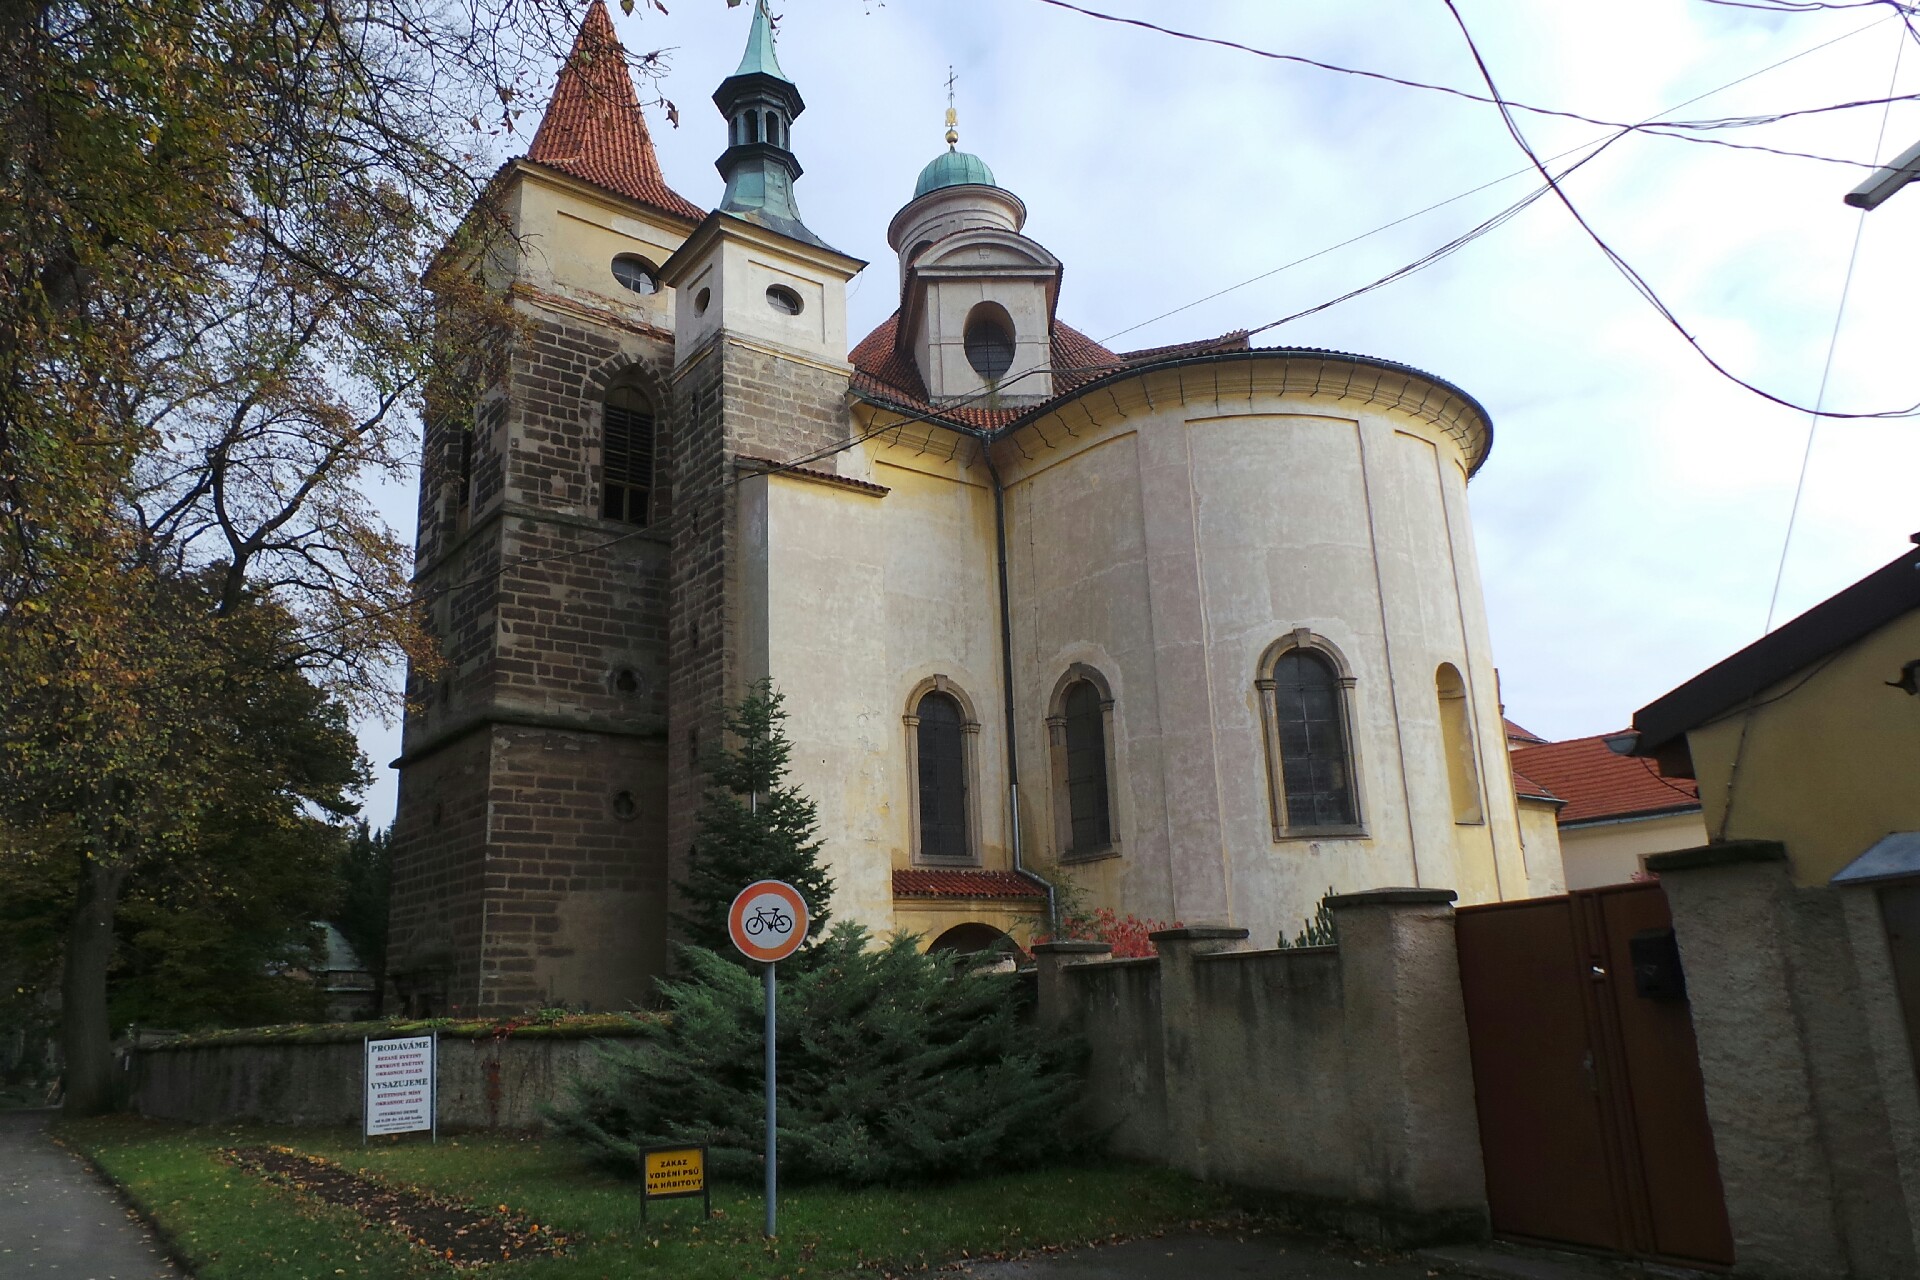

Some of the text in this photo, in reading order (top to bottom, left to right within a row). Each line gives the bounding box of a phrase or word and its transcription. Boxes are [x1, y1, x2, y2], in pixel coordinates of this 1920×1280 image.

[371, 1041, 429, 1053] PRODÁVÁME
[371, 1078, 428, 1090] VYSAZUJEME
[660, 1159, 688, 1168] ZÁKAZ
[682, 1166, 699, 1176] PSŮ
[660, 1179, 702, 1189] HŘBITOVY
